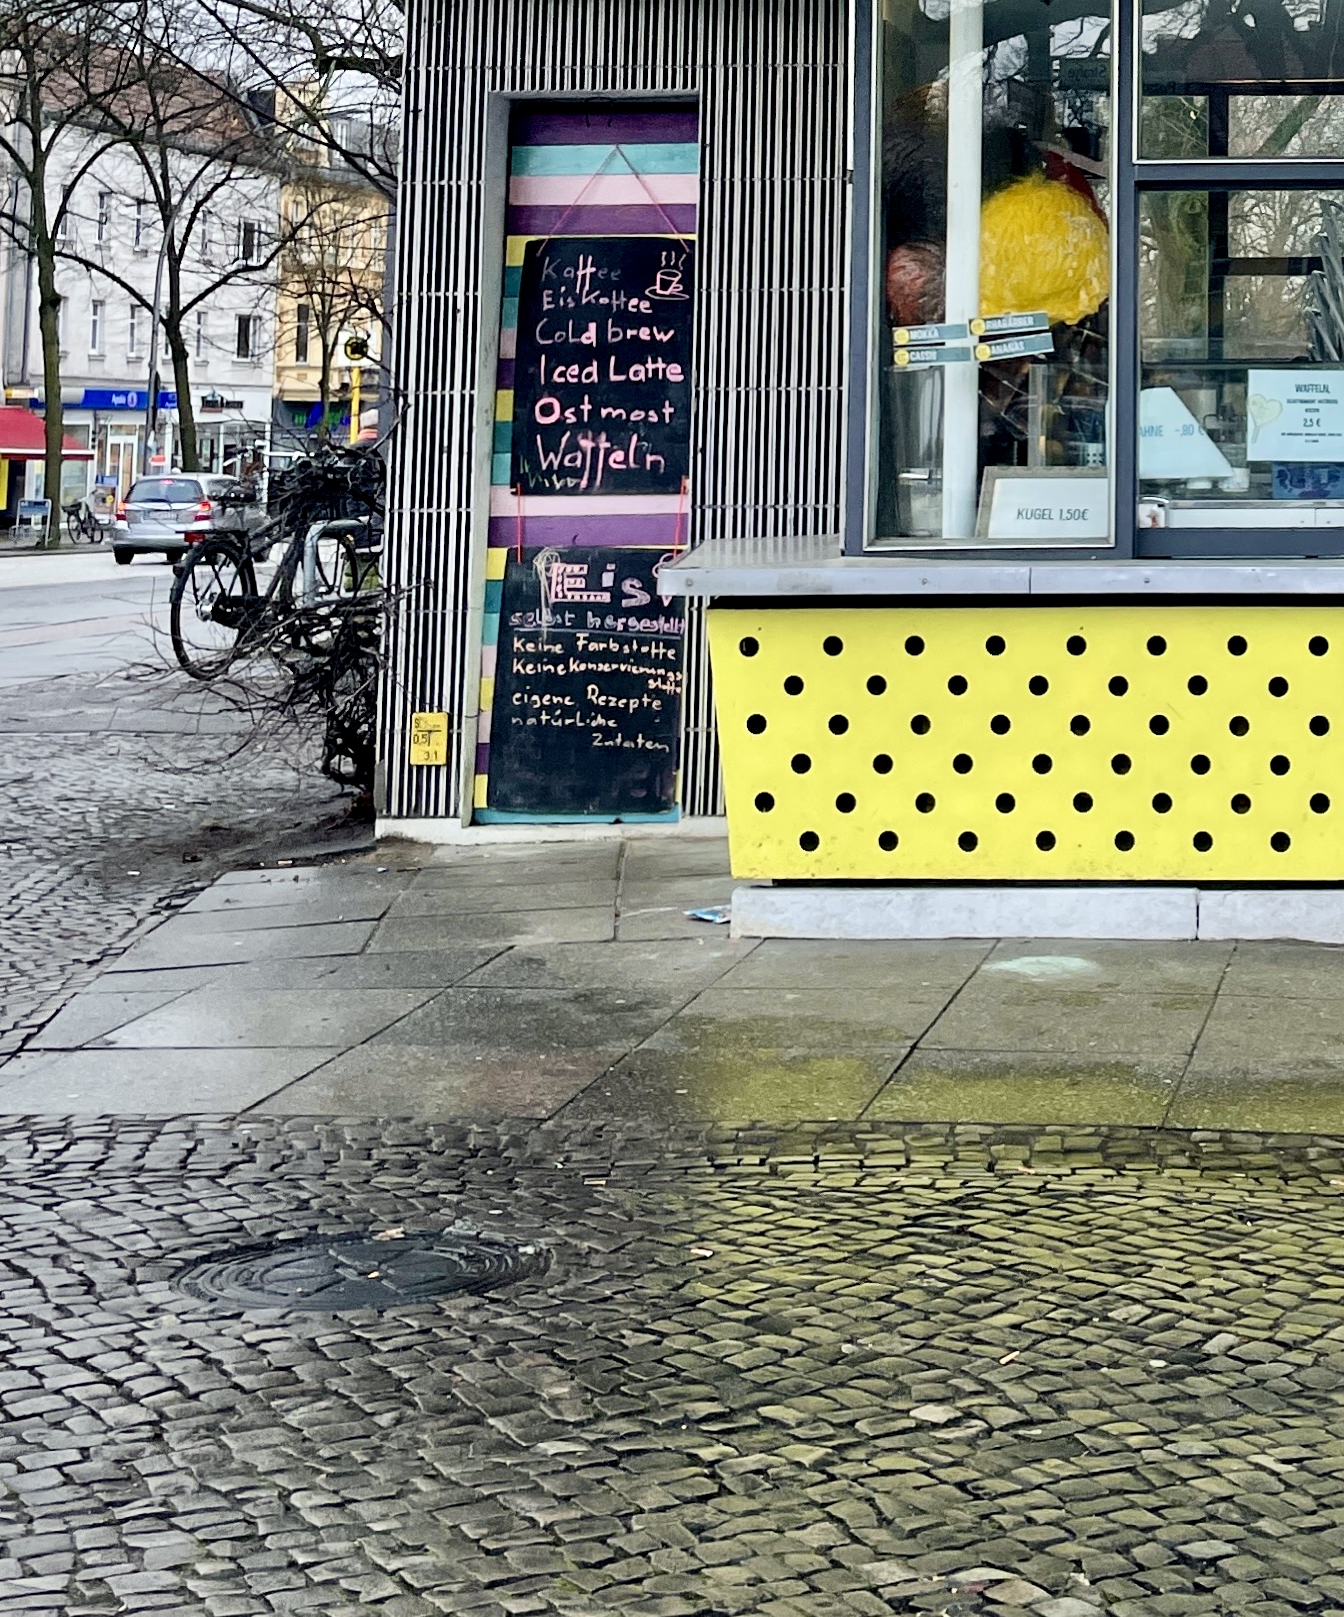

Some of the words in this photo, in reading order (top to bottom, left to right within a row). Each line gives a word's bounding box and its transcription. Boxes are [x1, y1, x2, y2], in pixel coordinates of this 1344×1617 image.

[541, 254, 622, 294] Kaffee
[608, 318, 675, 344] brew
[540, 354, 598, 384] Iced
[609, 355, 685, 383] Latte
[537, 431, 665, 490] Waffeln
[1016, 508, 1054, 520] KUGEL
[552, 562, 651, 608] Eis
[513, 636, 565, 654] Keine
[512, 658, 566, 676] Keine
[512, 686, 575, 708] eigene
[587, 683, 662, 713] Rezepte
[592, 733, 670, 753] Zutaten
